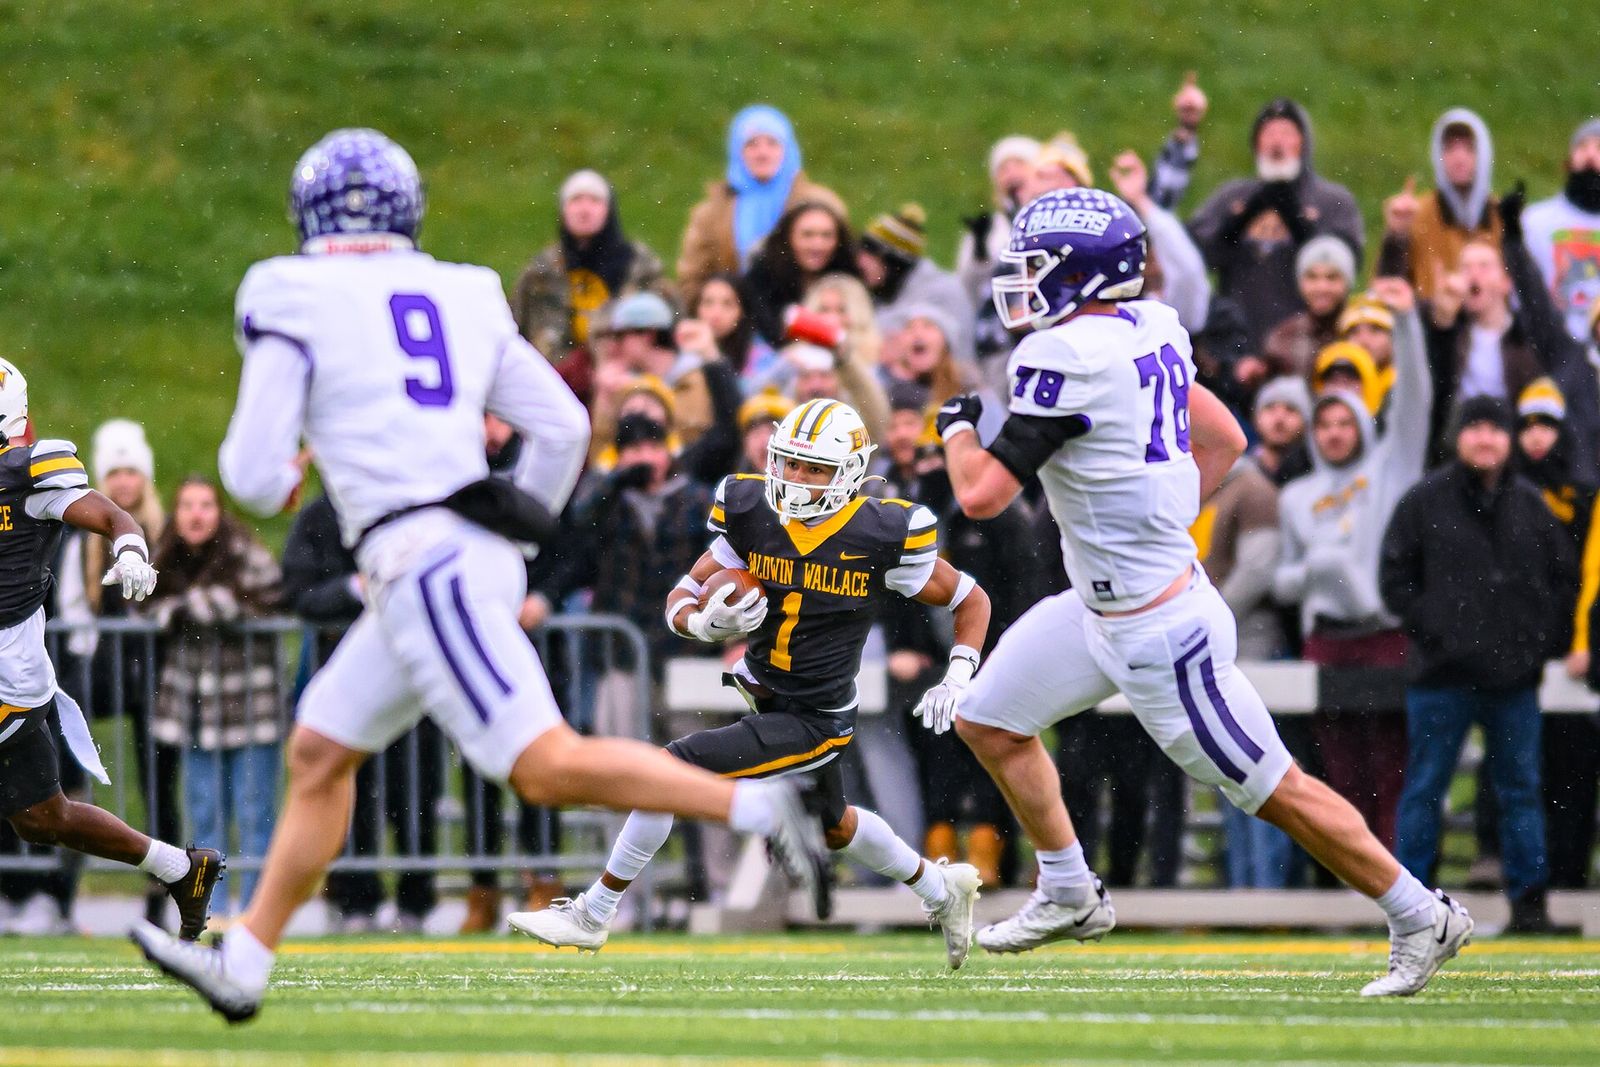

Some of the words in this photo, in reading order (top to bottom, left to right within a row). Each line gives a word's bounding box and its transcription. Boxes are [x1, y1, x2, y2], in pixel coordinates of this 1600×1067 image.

[1026, 209, 1112, 236] RAIDERS
[389, 294, 453, 406] 9
[1014, 366, 1065, 408] 78
[1134, 343, 1190, 463] 78
[788, 439, 814, 451] Riddell
[804, 562, 869, 597] WALLACE
[770, 591, 802, 672] 1
